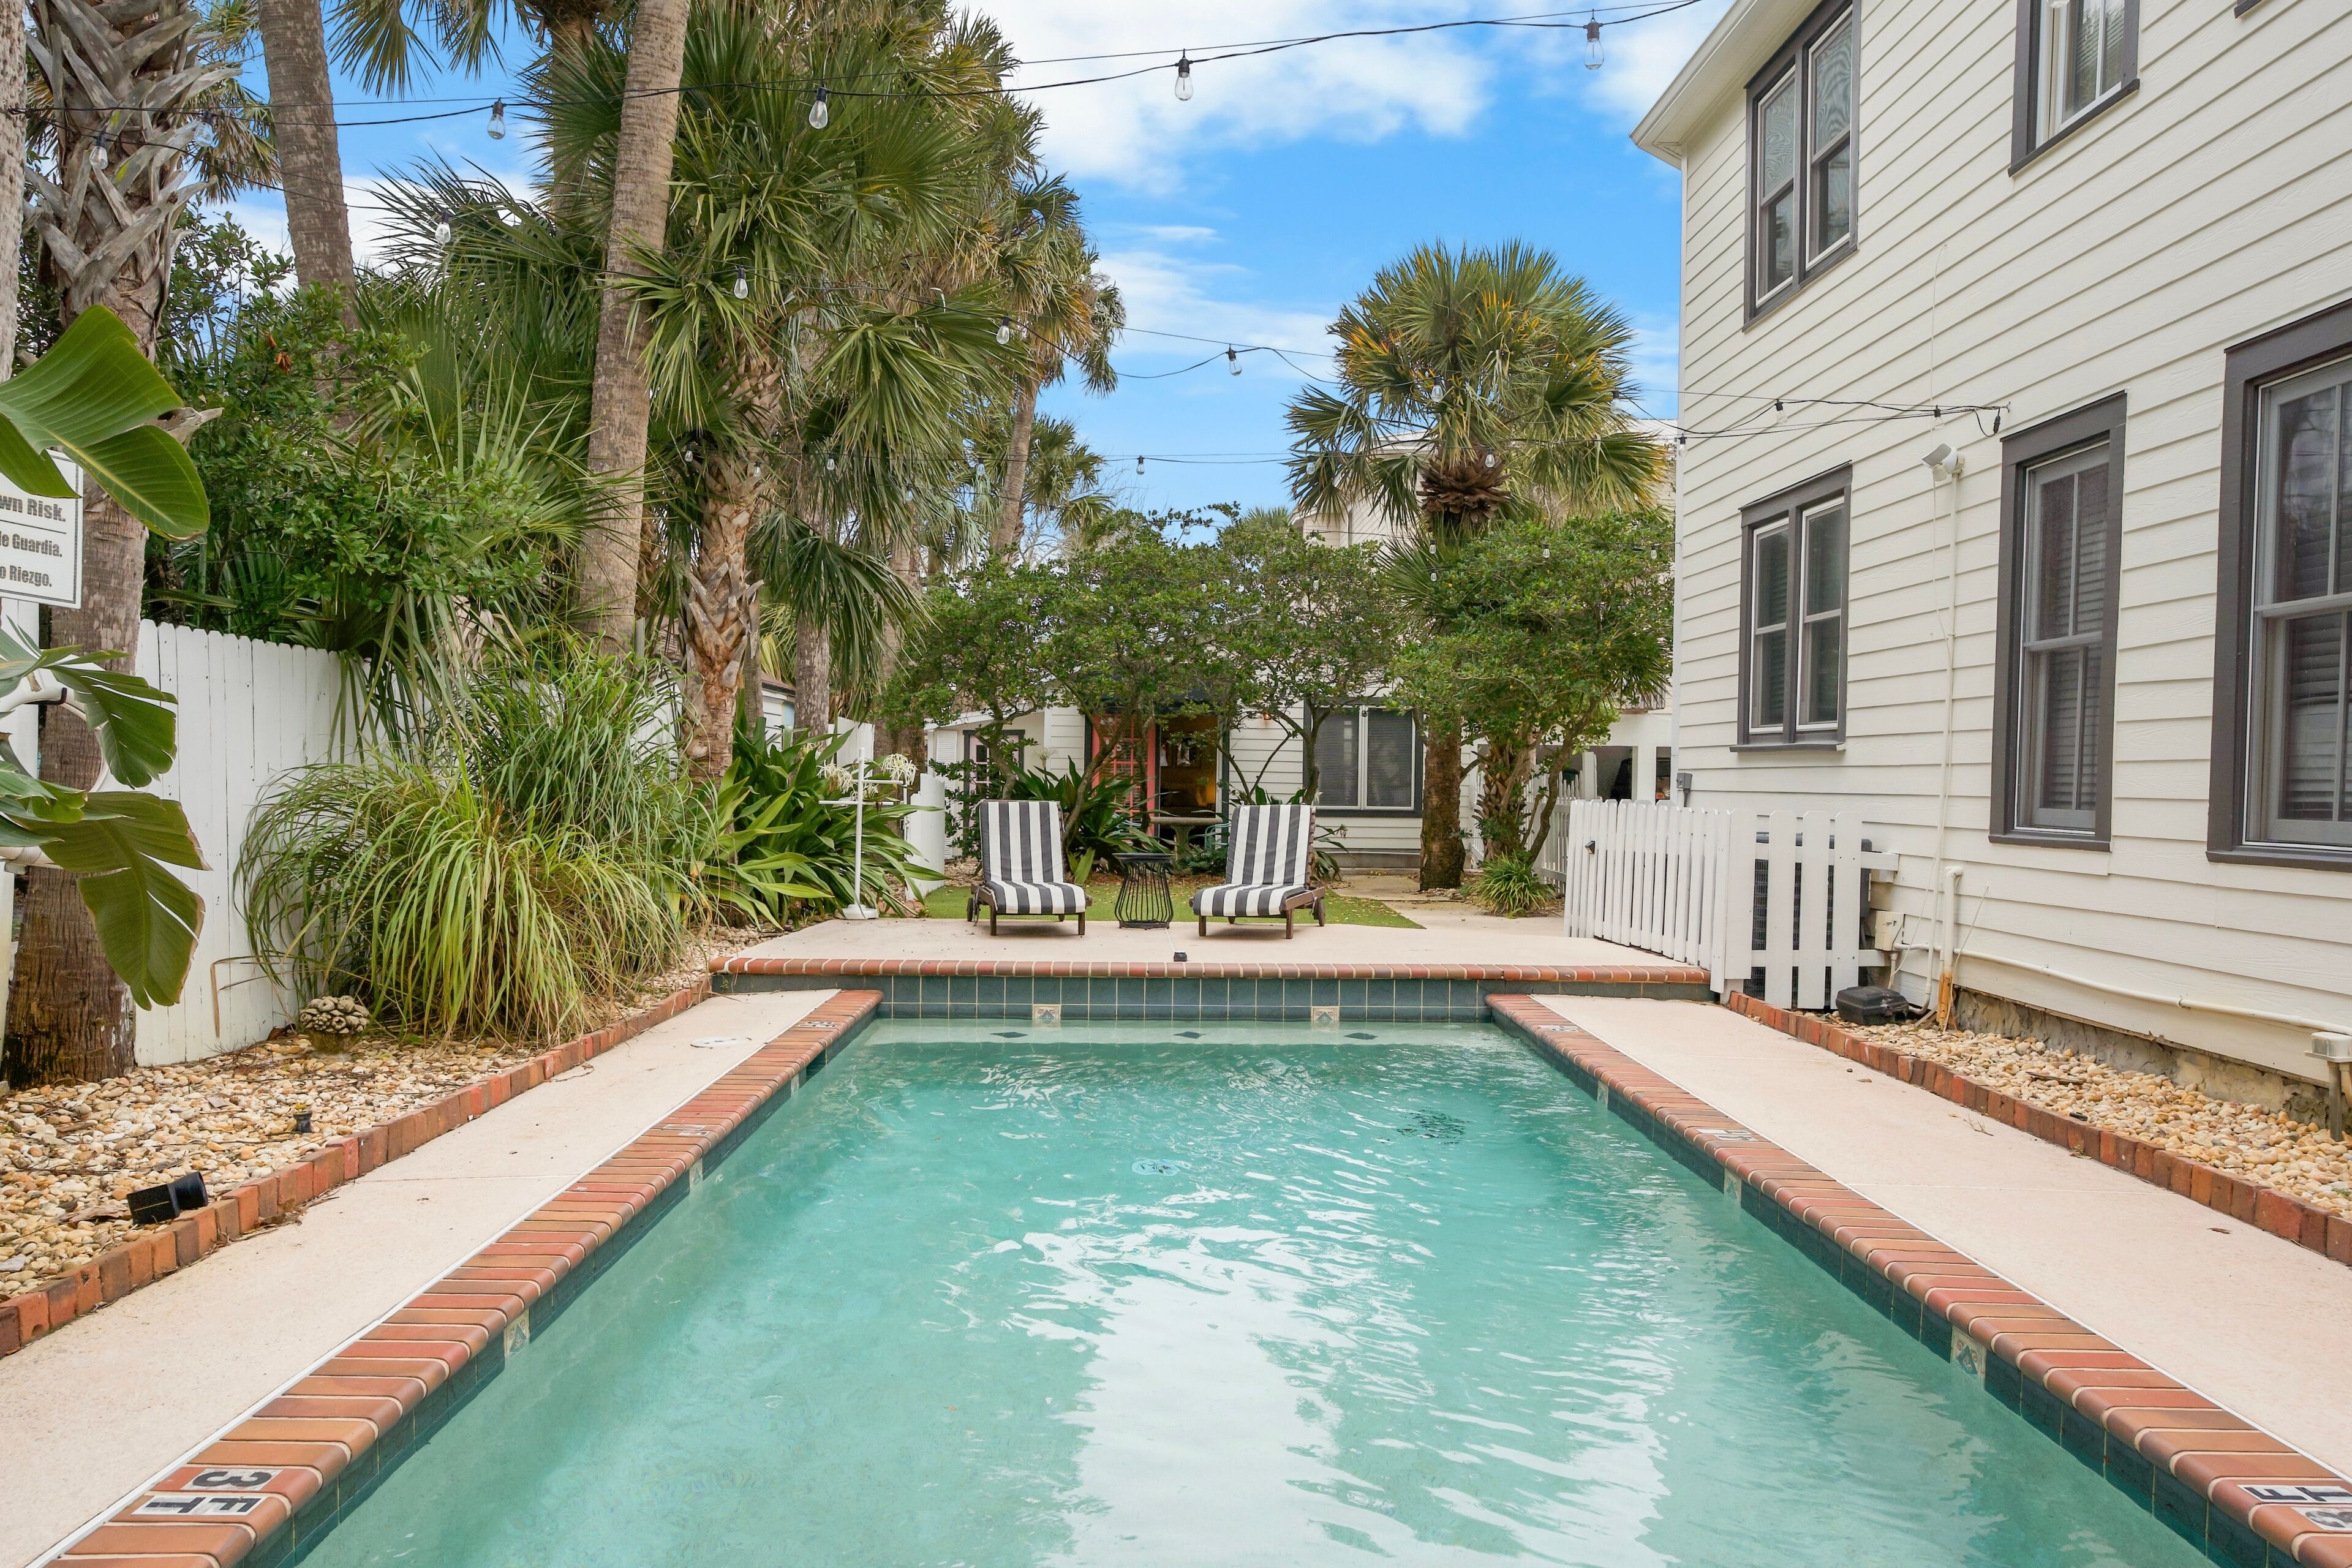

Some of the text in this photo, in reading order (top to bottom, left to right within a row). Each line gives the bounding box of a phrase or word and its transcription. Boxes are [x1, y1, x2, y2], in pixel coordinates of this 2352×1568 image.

[27, 498, 66, 522] Risk.
[0, 531, 62, 557] e Guardia.
[10, 565, 52, 587] Riezgo.
[145, 1471, 271, 1513] 3 FT
[2244, 1487, 2352, 1502] FT
